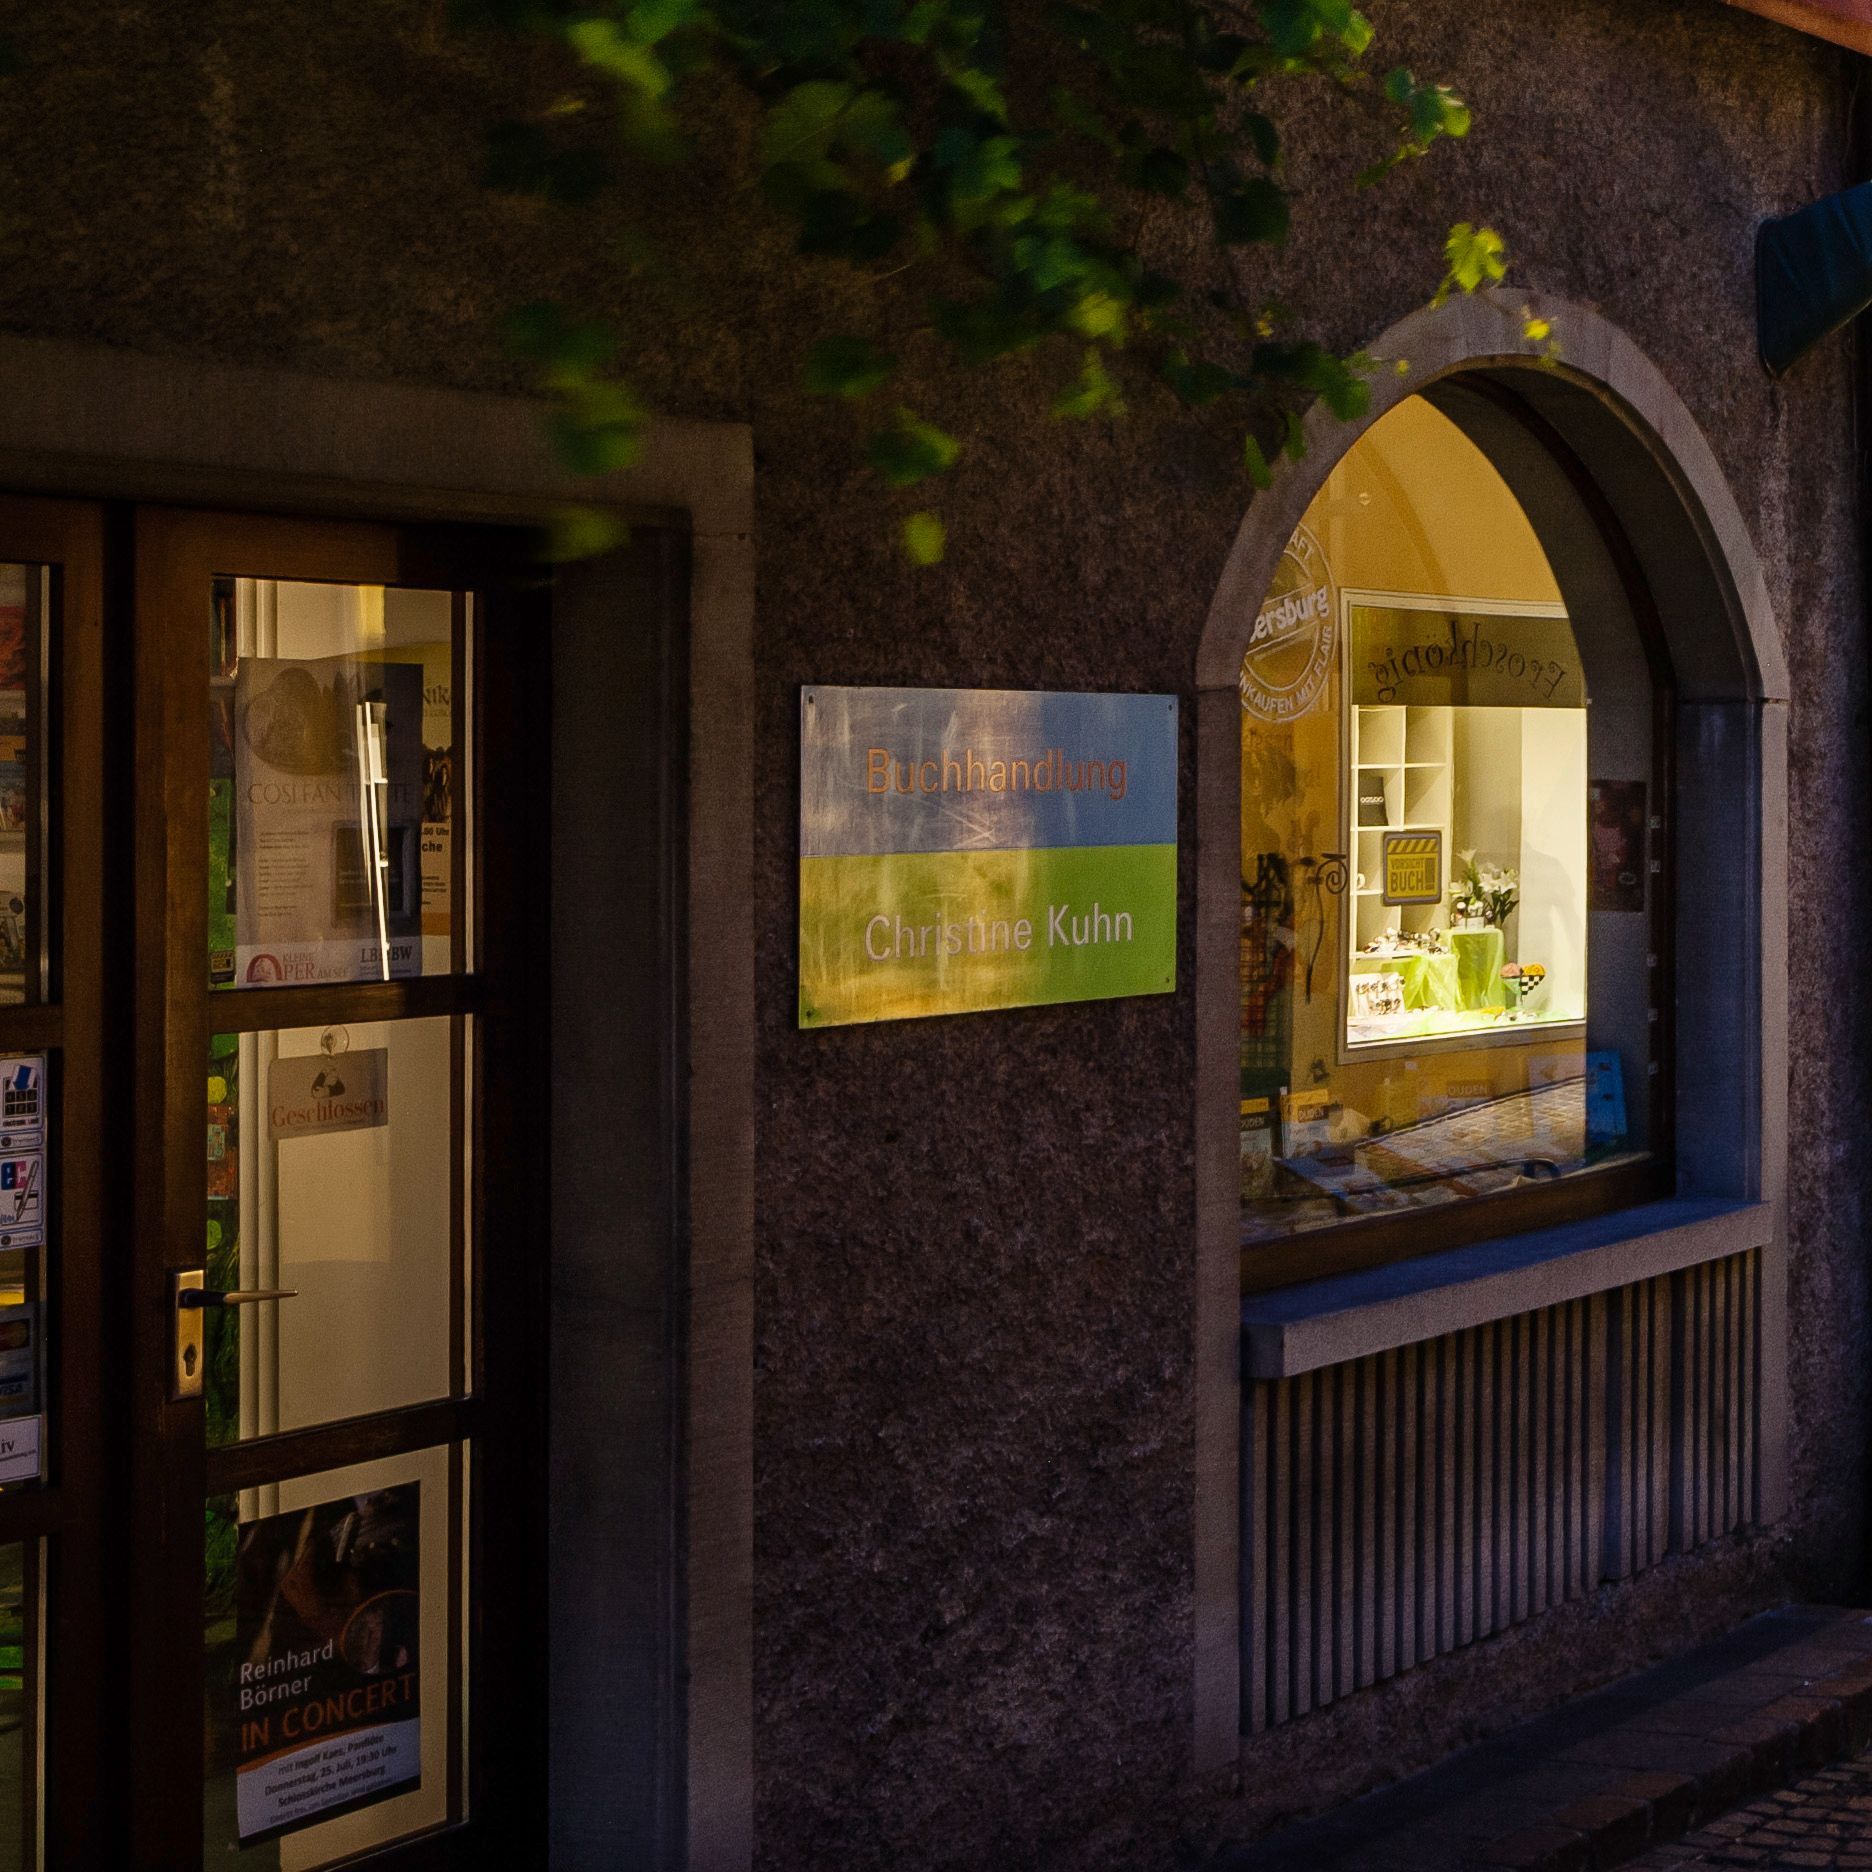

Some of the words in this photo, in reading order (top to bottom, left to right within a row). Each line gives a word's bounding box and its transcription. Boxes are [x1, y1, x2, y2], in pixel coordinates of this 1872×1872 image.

[1250, 585, 1329, 643] ersburg
[866, 747, 1129, 801] Buchhandlung
[865, 908, 1033, 963] Christine
[1047, 901, 1133, 948] Kuhn
[272, 1097, 384, 1127] Geschlossen
[240, 1638, 335, 1685] Reinhard
[240, 1674, 313, 1711] Börner
[241, 1716, 271, 1753] IN
[281, 1671, 417, 1739] CONCERT
